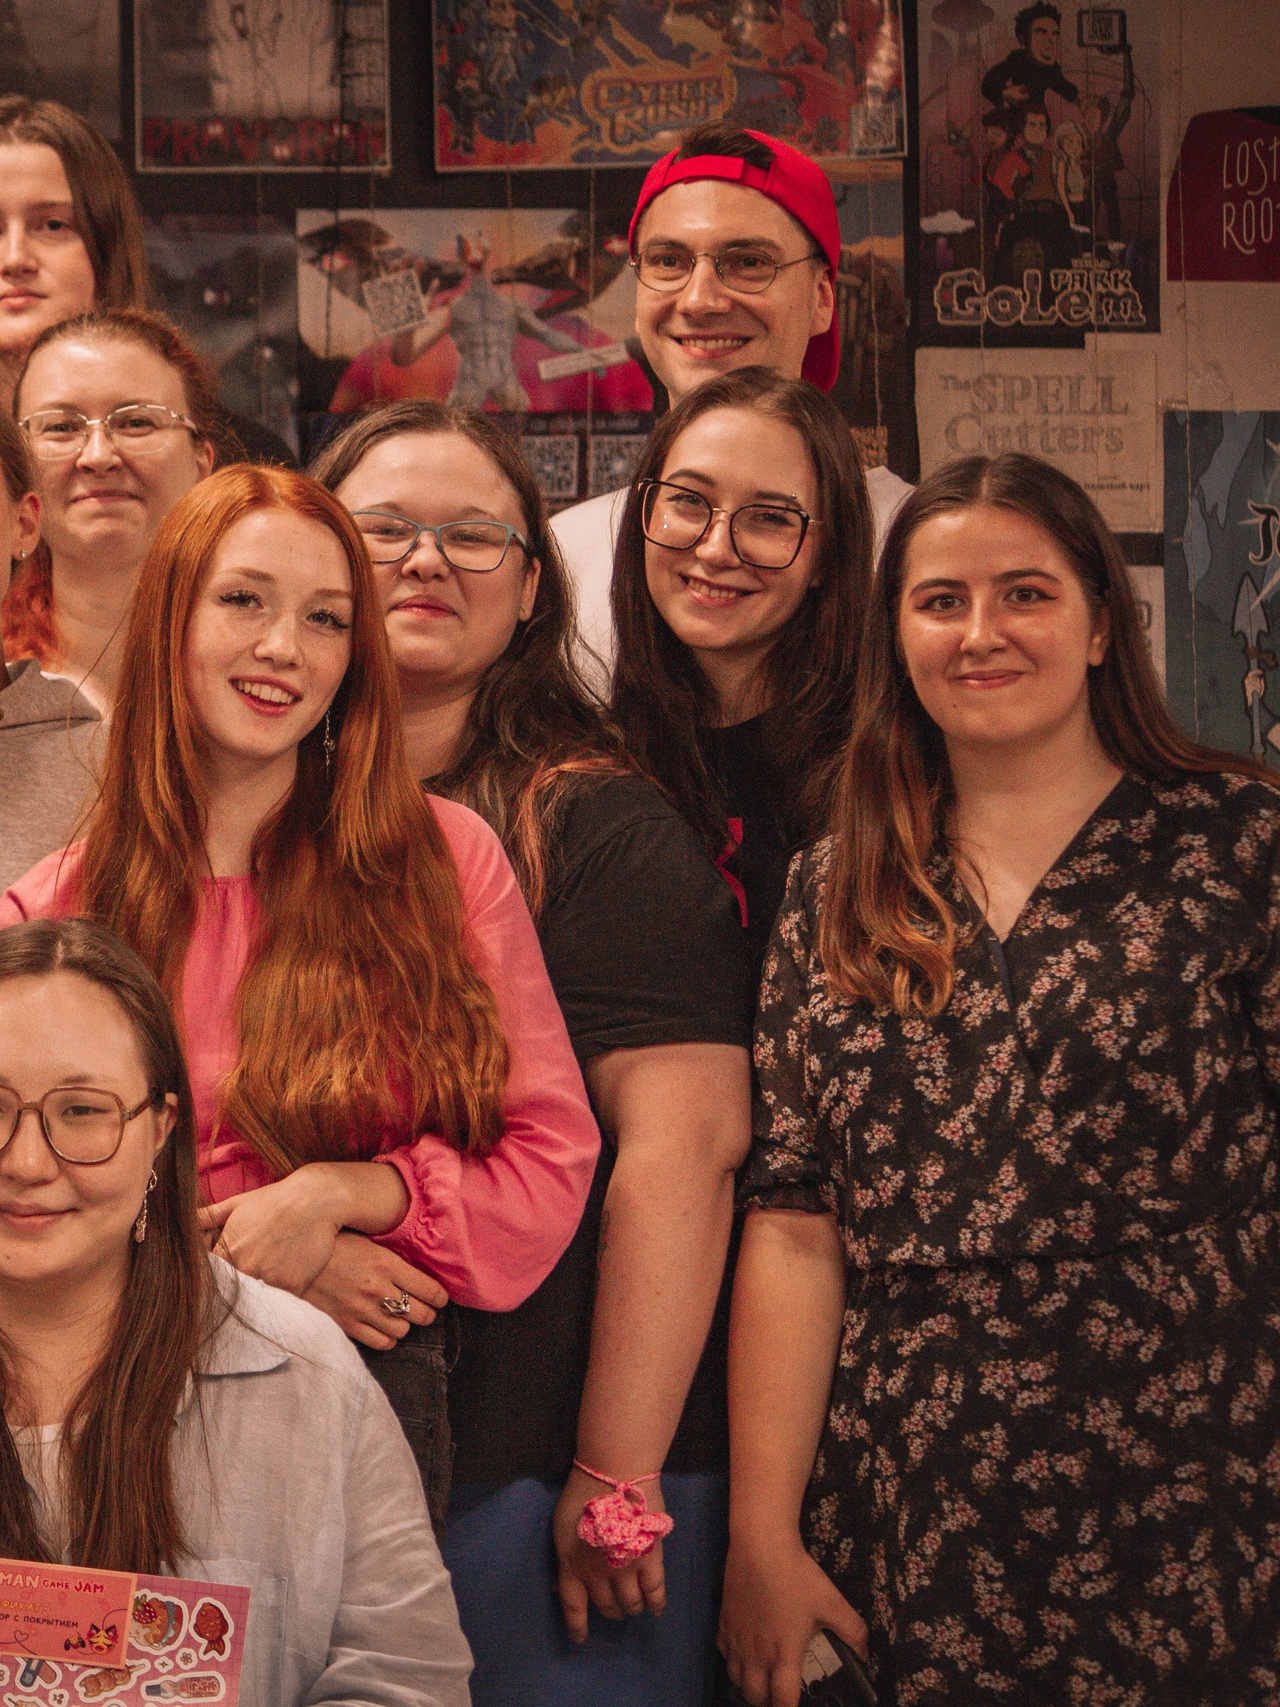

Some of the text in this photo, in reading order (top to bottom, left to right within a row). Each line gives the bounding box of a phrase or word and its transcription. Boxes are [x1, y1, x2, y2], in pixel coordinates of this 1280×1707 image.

[597, 79, 720, 108] CYBER
[613, 101, 707, 138] RUSH
[1222, 197, 1280, 254] ROO
[972, 372, 1129, 415] SPELL
[42, 1579, 71, 1590] GAME
[74, 1581, 105, 1594] JAM
[23, 1615, 79, 1628] ПОКРЫТИЕМ
